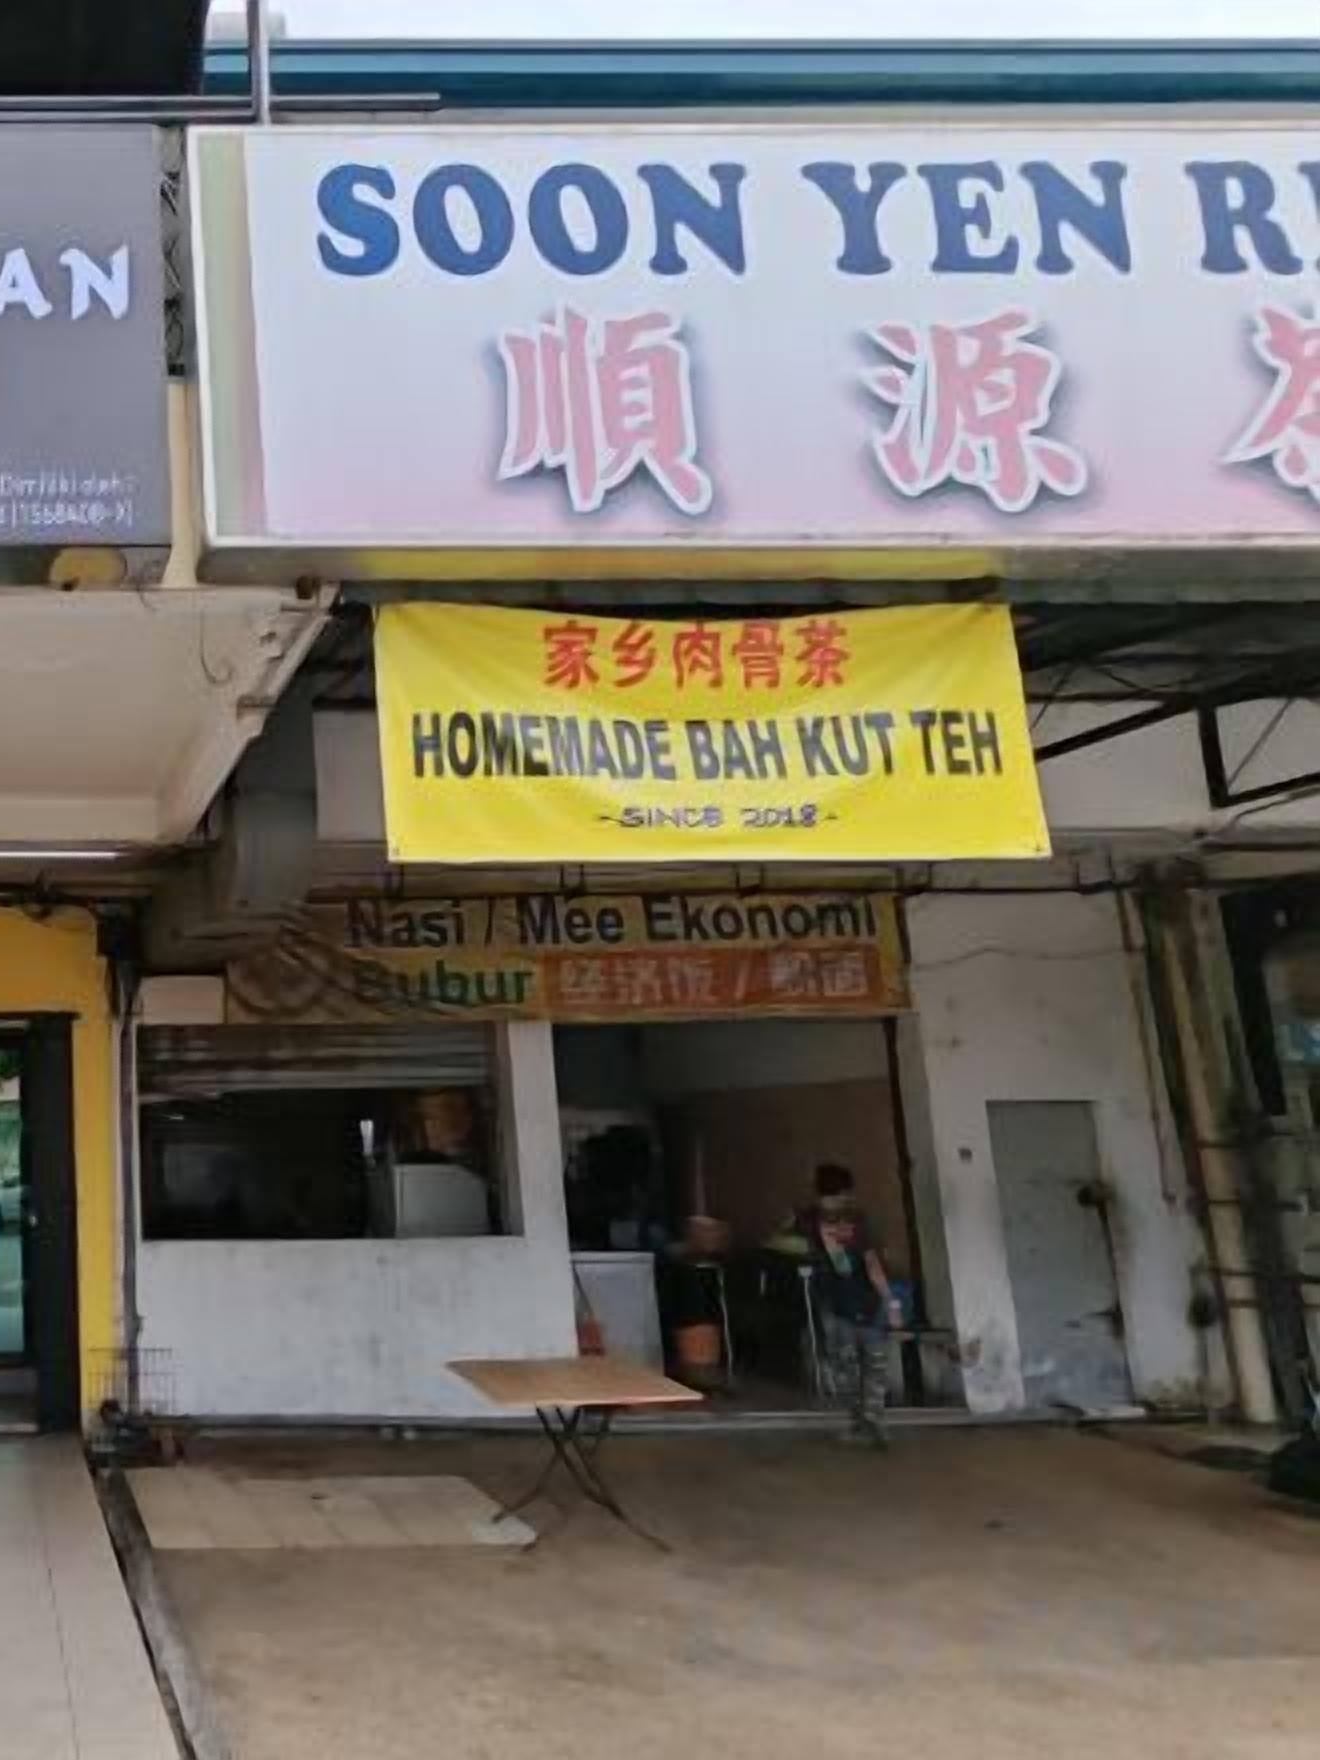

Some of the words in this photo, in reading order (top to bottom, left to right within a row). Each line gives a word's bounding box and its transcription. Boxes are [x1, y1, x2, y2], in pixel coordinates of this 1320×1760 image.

[316, 162, 748, 277] SOON
[800, 160, 1132, 276] YEN
[1184, 160, 1320, 276] R
[543, 619, 851, 690] 家乡肉骨茶
[412, 711, 677, 780] HOMEMADE
[684, 718, 788, 780] BAH
[794, 708, 895, 778] KUT
[910, 709, 1003, 776] TEH
[345, 894, 468, 949] Nasi
[515, 890, 626, 946] Mee
[646, 891, 877, 942] Ekonomi
